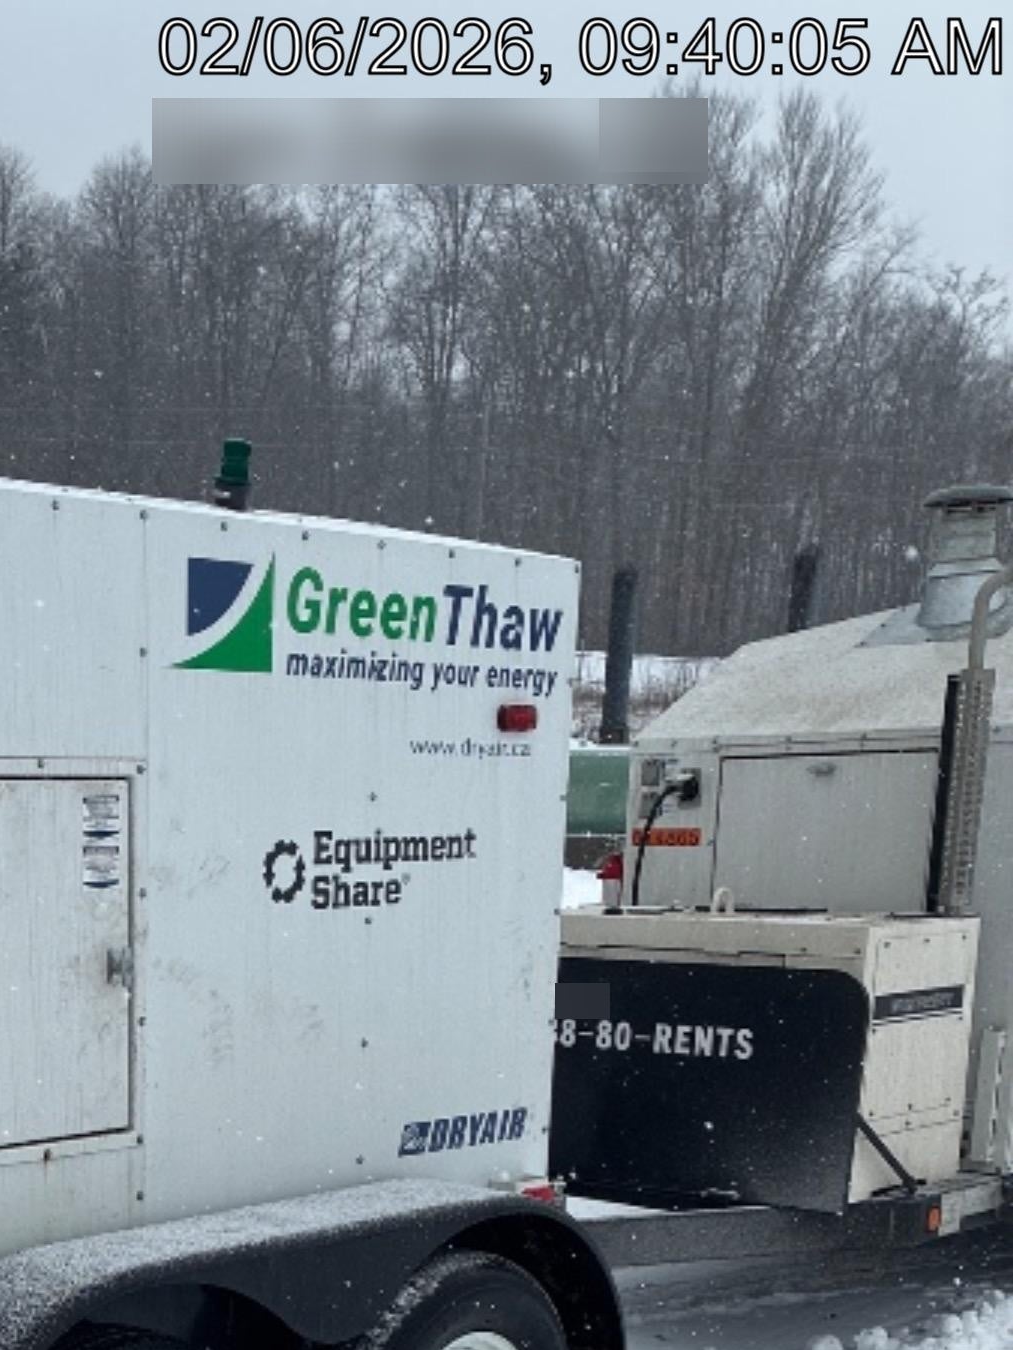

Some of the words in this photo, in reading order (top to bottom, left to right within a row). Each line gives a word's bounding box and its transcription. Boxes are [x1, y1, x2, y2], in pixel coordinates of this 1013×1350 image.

[287, 566, 564, 652] GreenThaw
[286, 647, 425, 691] maximizing
[430, 661, 480, 692] your
[487, 665, 558, 698] energy
[312, 827, 477, 873] Equipment
[554, 1018, 754, 1061] 8-80-RENTS
[428, 1107, 528, 1153] DRYAIR
